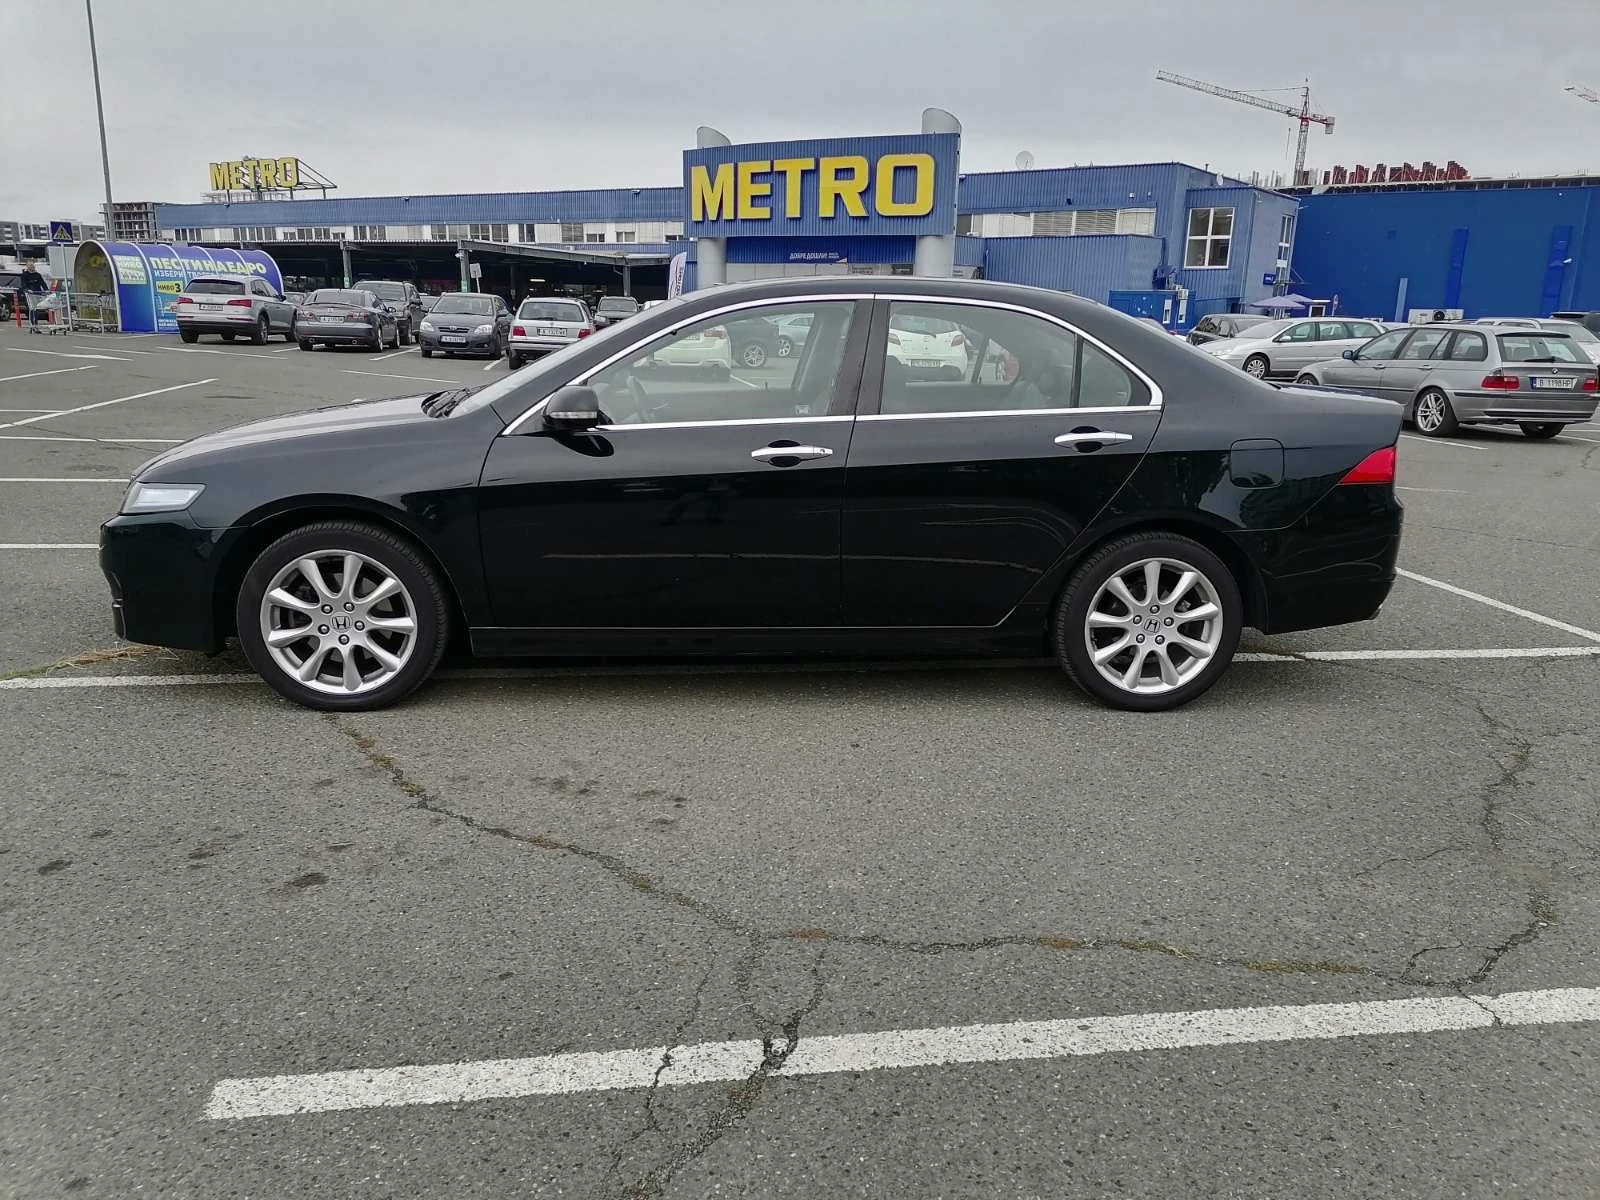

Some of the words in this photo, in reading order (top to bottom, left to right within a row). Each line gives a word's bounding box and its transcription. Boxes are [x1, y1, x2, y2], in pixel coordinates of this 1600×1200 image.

[209, 157, 298, 190] METRO
[691, 153, 935, 221] METRO
[149, 257, 203, 271] ПЕСТИ
[201, 259, 227, 273] НА
[225, 261, 267, 275] ЕДРО
[154, 269, 185, 278] ИЗБЕРИ
[174, 282, 182, 293] 3
